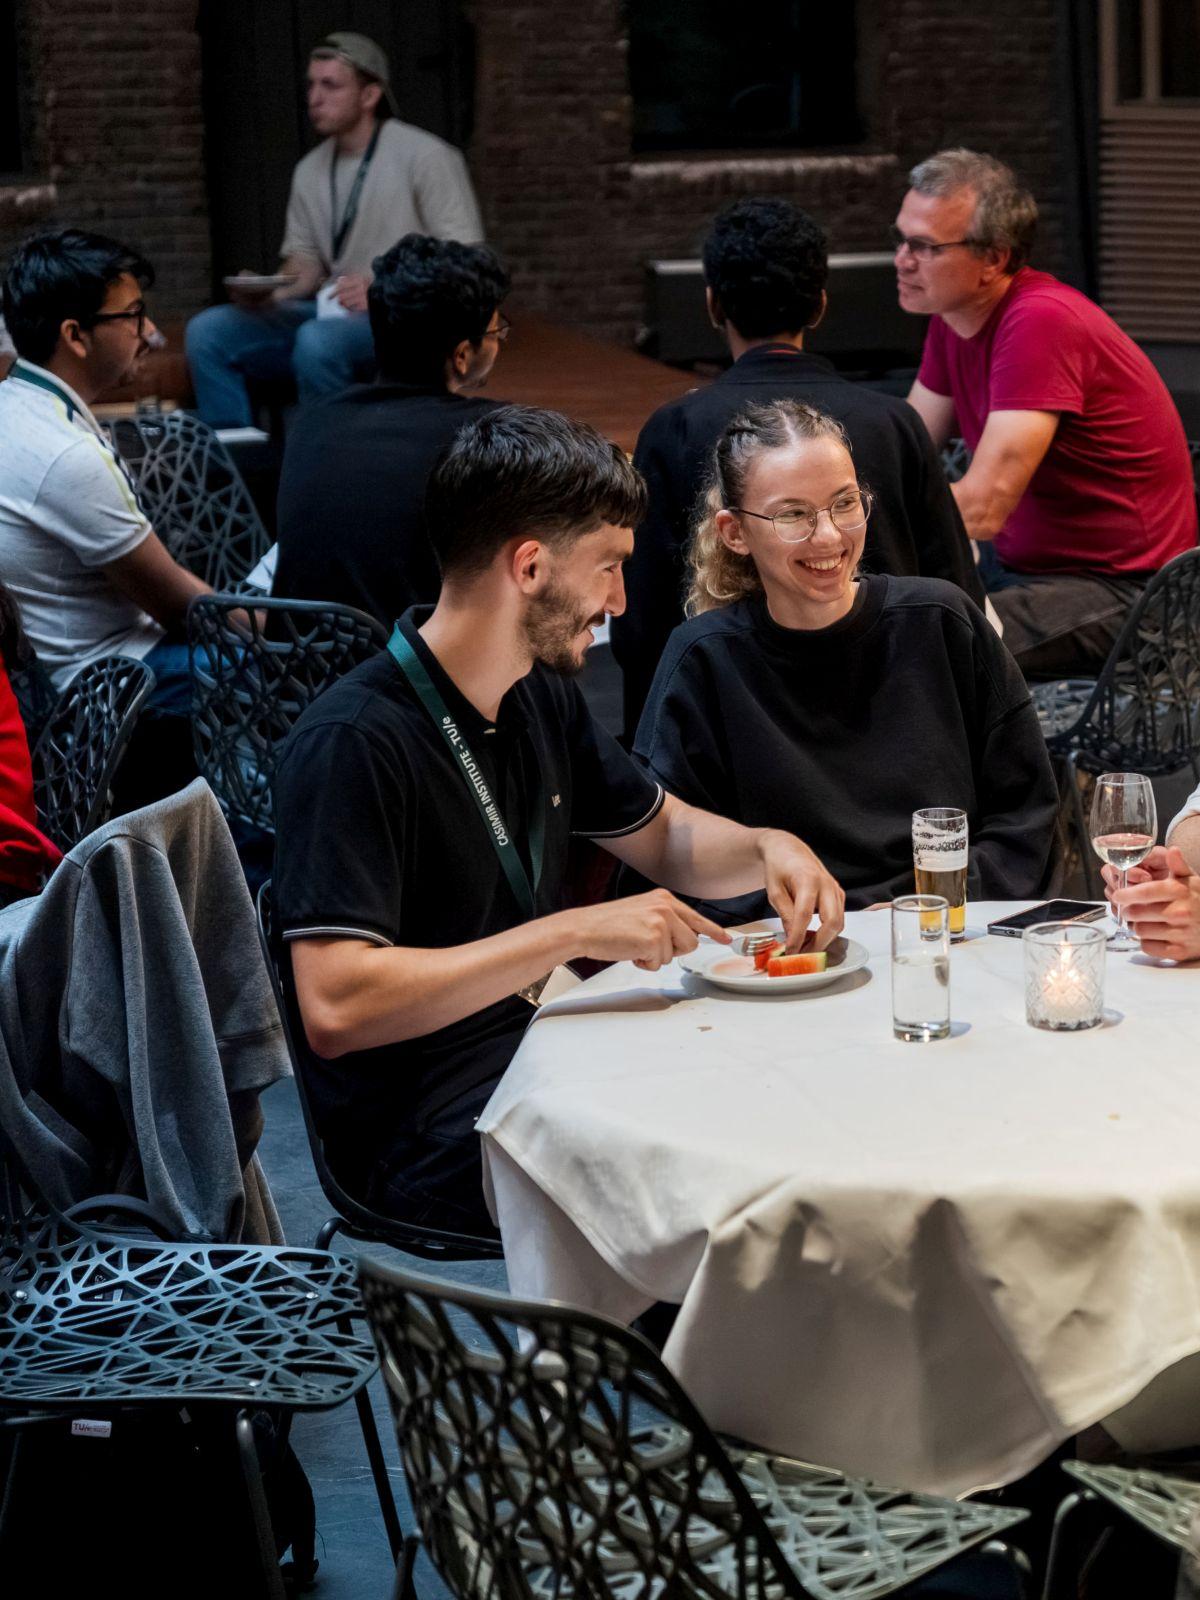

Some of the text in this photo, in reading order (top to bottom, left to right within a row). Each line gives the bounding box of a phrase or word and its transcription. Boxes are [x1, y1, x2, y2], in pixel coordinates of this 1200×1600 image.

[442, 715, 462, 746] TU/e
[459, 749, 492, 805] INSTITUTE
[485, 803, 509, 846] CASIMIR
